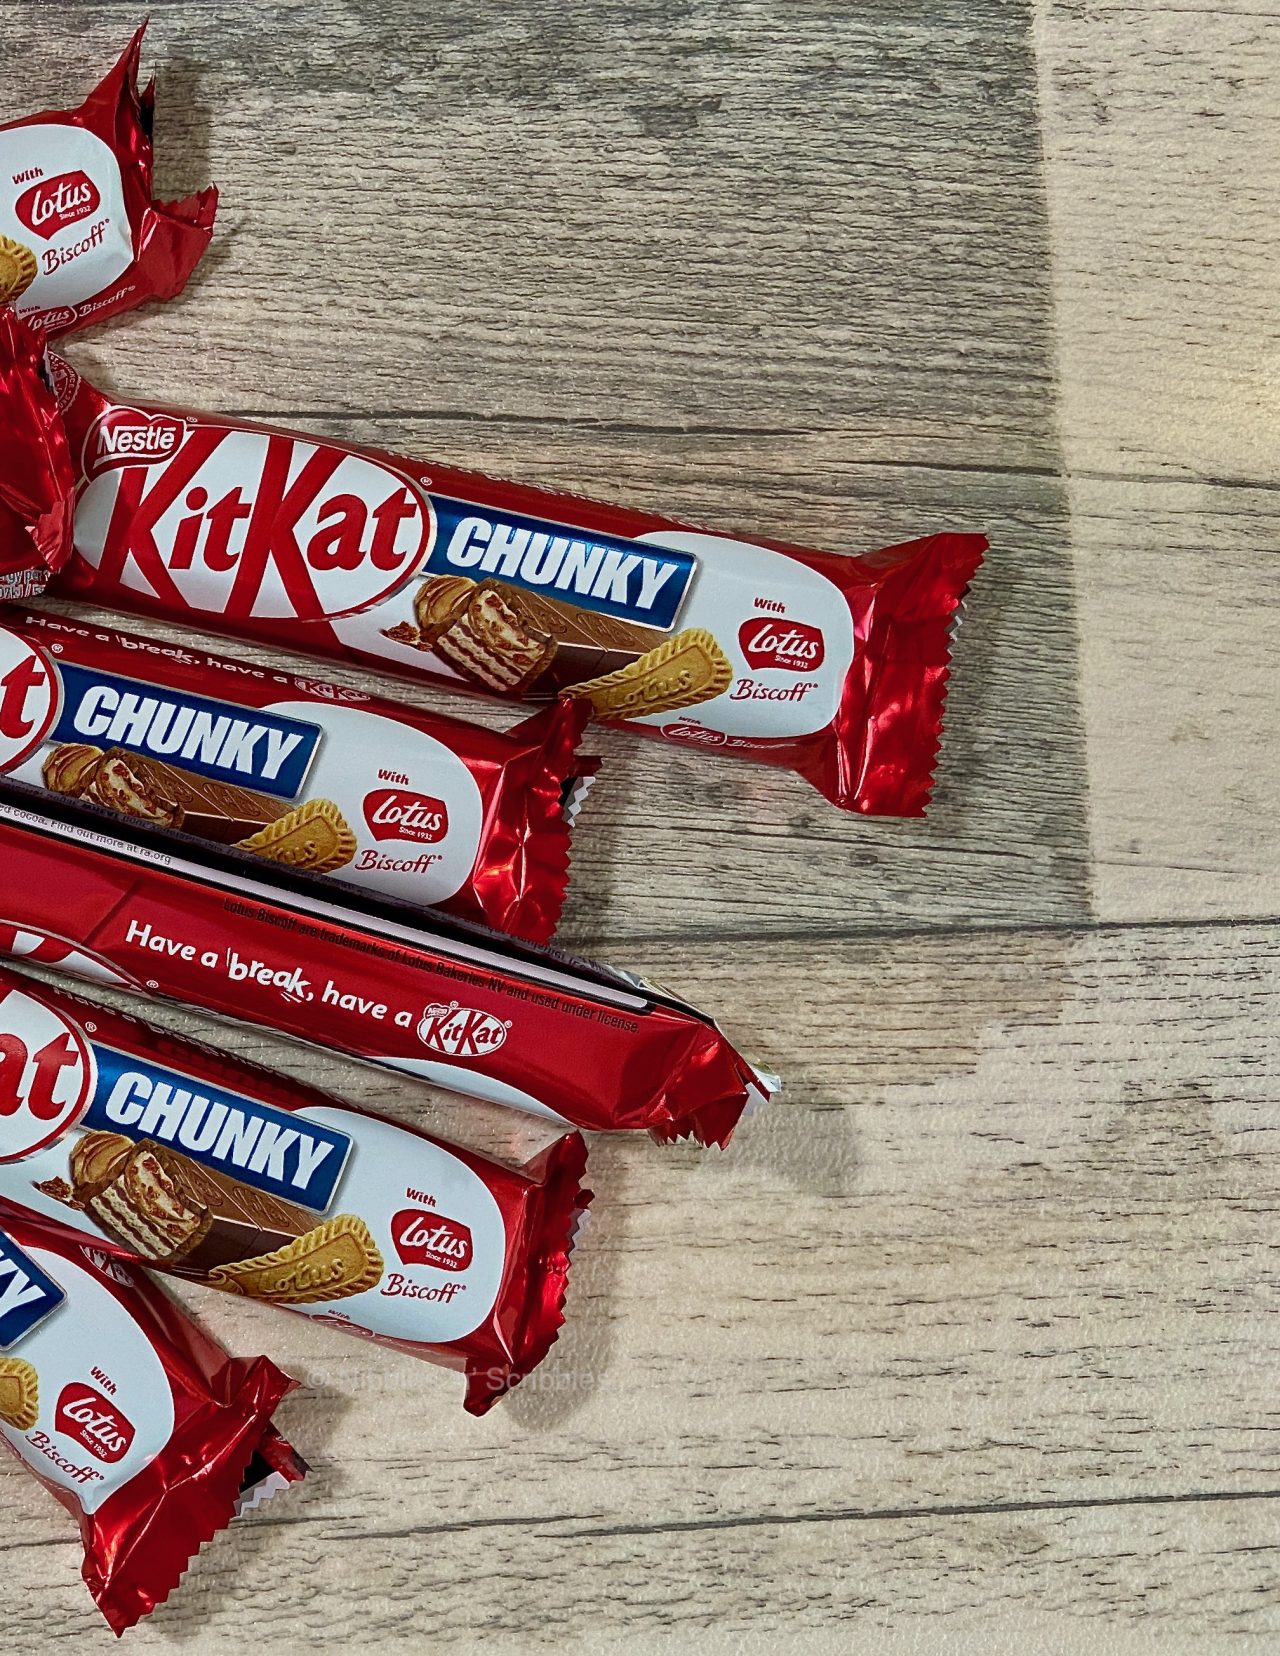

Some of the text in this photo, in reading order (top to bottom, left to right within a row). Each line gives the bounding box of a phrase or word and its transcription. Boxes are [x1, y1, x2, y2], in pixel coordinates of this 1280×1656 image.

[12, 167, 43, 184] With
[31, 182, 90, 226] Lotus
[42, 220, 106, 276] Biscoff
[79, 287, 128, 317] Biscoff
[98, 424, 176, 455] Nestlé
[92, 428, 418, 617] KitKat
[446, 517, 680, 611] CHUNKY
[754, 597, 786, 613] With
[26, 616, 89, 637] Have
[95, 633, 110, 642] a
[207, 658, 265, 679] have
[748, 624, 819, 659] Lotus
[730, 679, 812, 702] Biscoff
[73, 686, 303, 780] CHUNKY
[378, 769, 409, 785] With
[372, 795, 442, 830] Lotus
[50, 819, 74, 833] Find
[76, 827, 94, 840] out
[95, 832, 124, 849] more
[126, 841, 139, 853] at
[139, 844, 172, 866] ra.org
[355, 850, 436, 873] Biscoff
[224, 899, 255, 924] Lotus
[257, 906, 297, 934] Biscoff
[298, 919, 318, 938] are
[319, 923, 384, 958] trademarks
[386, 945, 401, 962] of
[402, 949, 433, 974] Lotus
[435, 958, 485, 991] Bakeries
[486, 974, 507, 994] NV
[507, 984, 529, 1003] and
[531, 988, 559, 1011] used
[560, 998, 596, 1022] under
[125, 919, 196, 965] Have
[201, 951, 218, 969] a
[321, 985, 385, 1022] have
[395, 1011, 413, 1029] a
[425, 1008, 508, 1054] KitKat
[106, 1071, 335, 1190] CHUNKY
[406, 1187, 437, 1207] With
[400, 1217, 468, 1258] Lotus
[380, 1273, 460, 1303] Biscoff
[91, 1366, 117, 1395] With
[63, 1398, 126, 1451] Lotus
[25, 1431, 100, 1483] Biscoff
